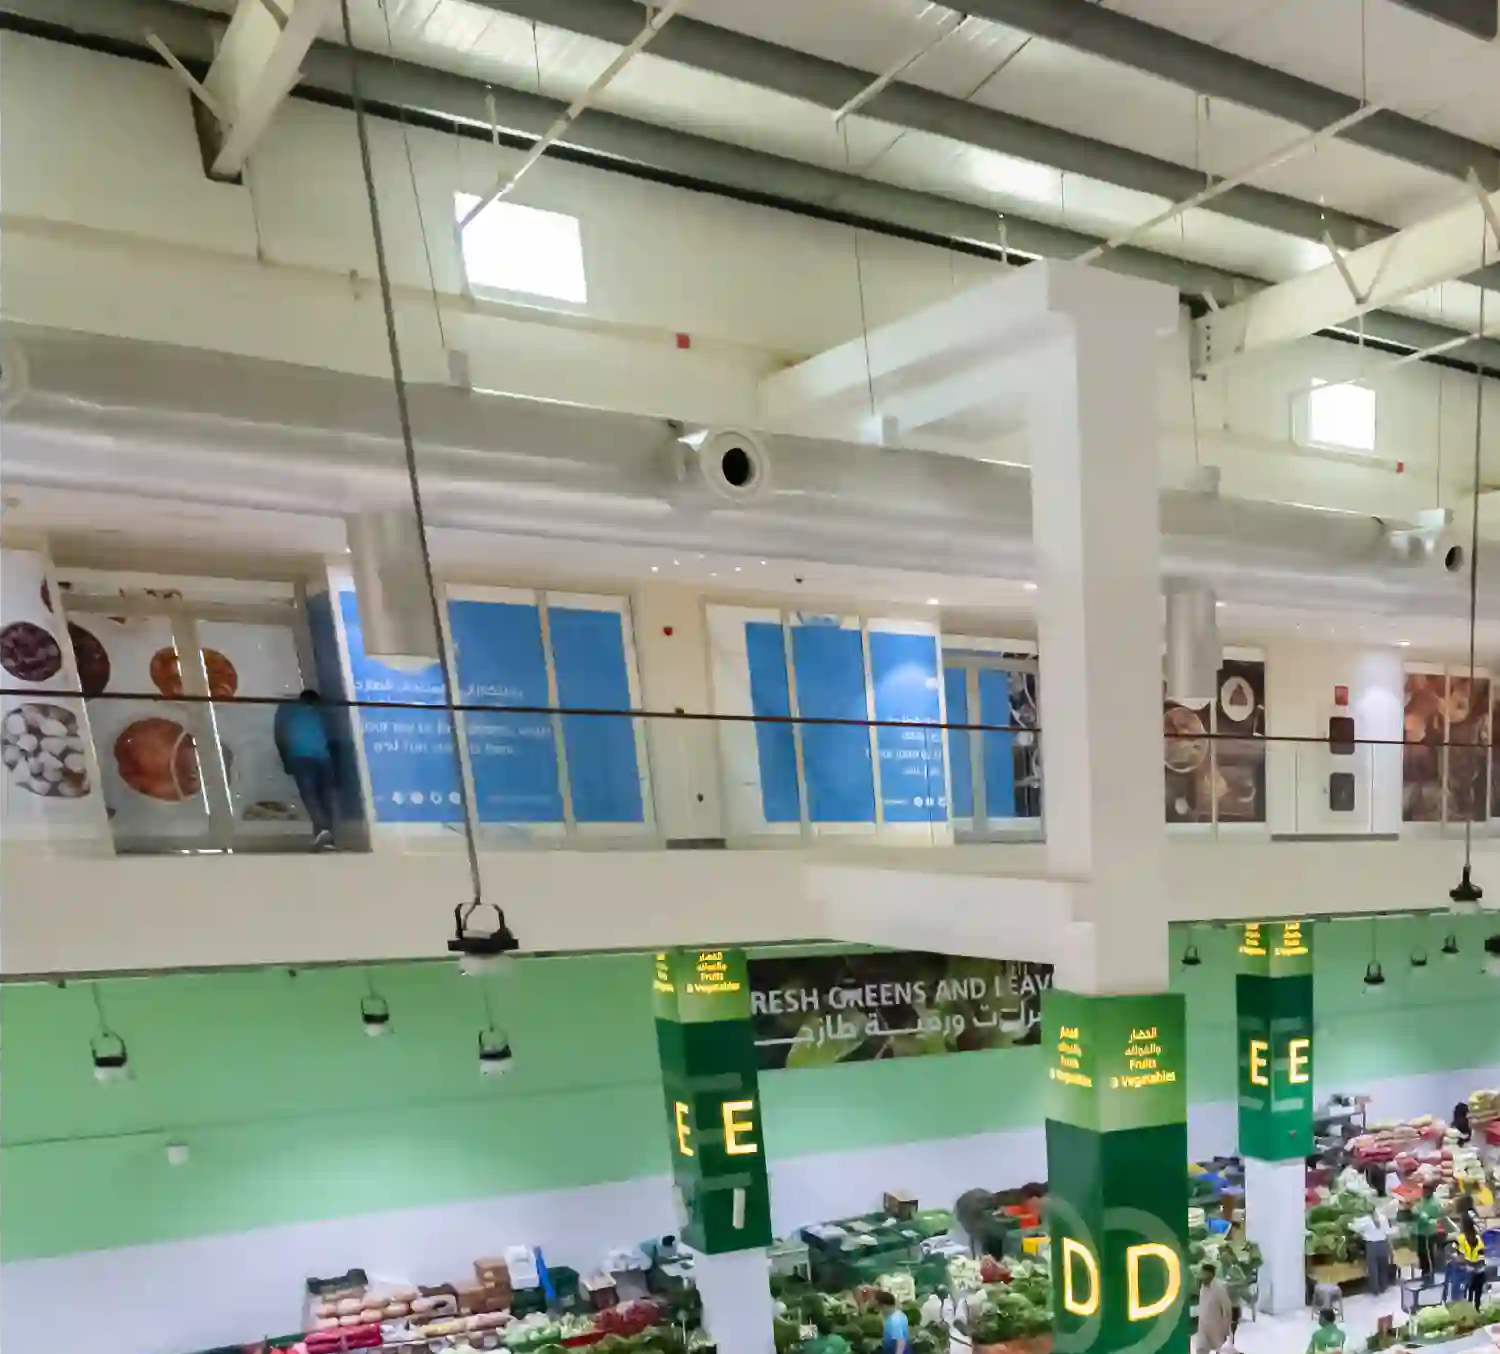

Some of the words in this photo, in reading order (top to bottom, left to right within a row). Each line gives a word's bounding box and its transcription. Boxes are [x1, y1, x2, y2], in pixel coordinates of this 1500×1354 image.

[750, 987, 819, 1015] RESH
[936, 976, 987, 1002] AND
[994, 973, 1050, 997] LEAV
[1121, 1070, 1176, 1089] Vegetables
[1250, 1039, 1269, 1086] E
[1289, 1038, 1309, 1084] E
[674, 1101, 694, 1156] E
[723, 1100, 757, 1155] E
[1063, 1236, 1099, 1316] D
[1126, 1242, 1181, 1321] D
